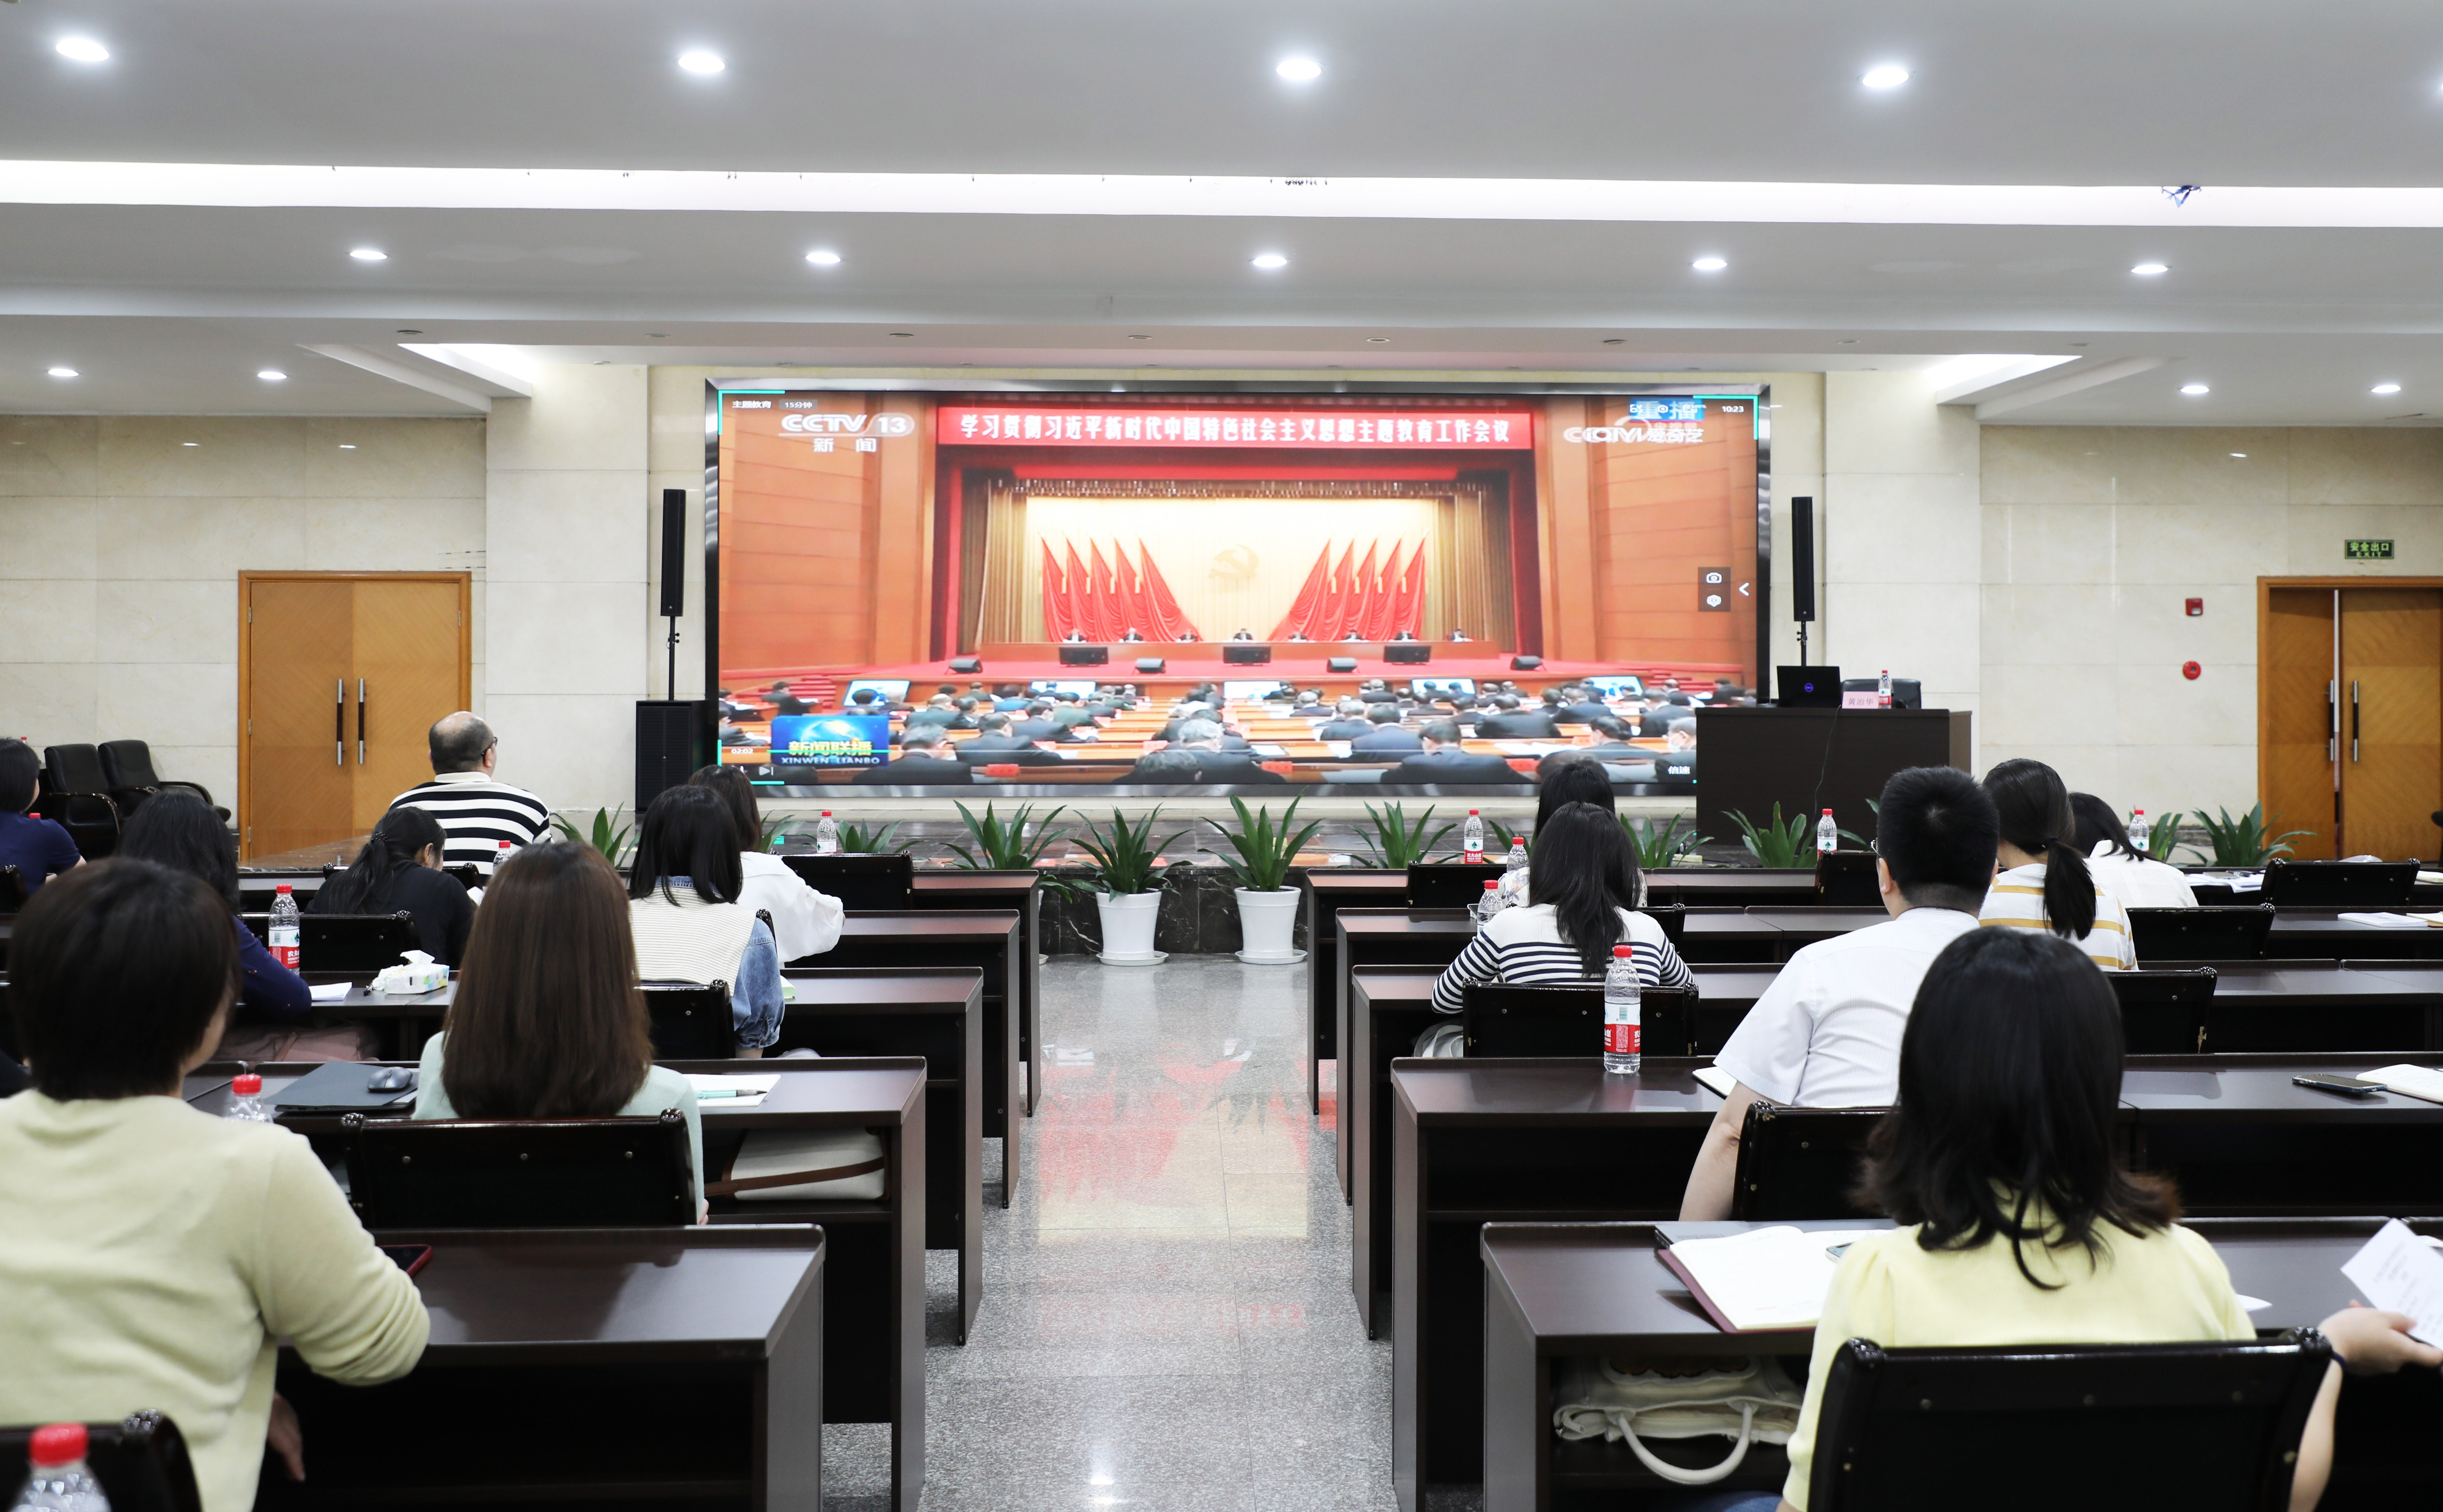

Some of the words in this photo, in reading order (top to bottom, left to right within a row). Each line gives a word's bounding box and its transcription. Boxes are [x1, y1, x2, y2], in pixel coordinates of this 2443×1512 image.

[732, 400, 771, 409] 主题教育
[781, 414, 867, 432] CCTV
[878, 417, 906, 433] 13
[960, 414, 1510, 443] 学习贯彻习近平新时代中国特色社会主义思想主题教育工作会议
[1646, 427, 1704, 443] 爱奇艺
[2350, 541, 2389, 552] 安全出口
[789, 741, 872, 756] 新闻联播
